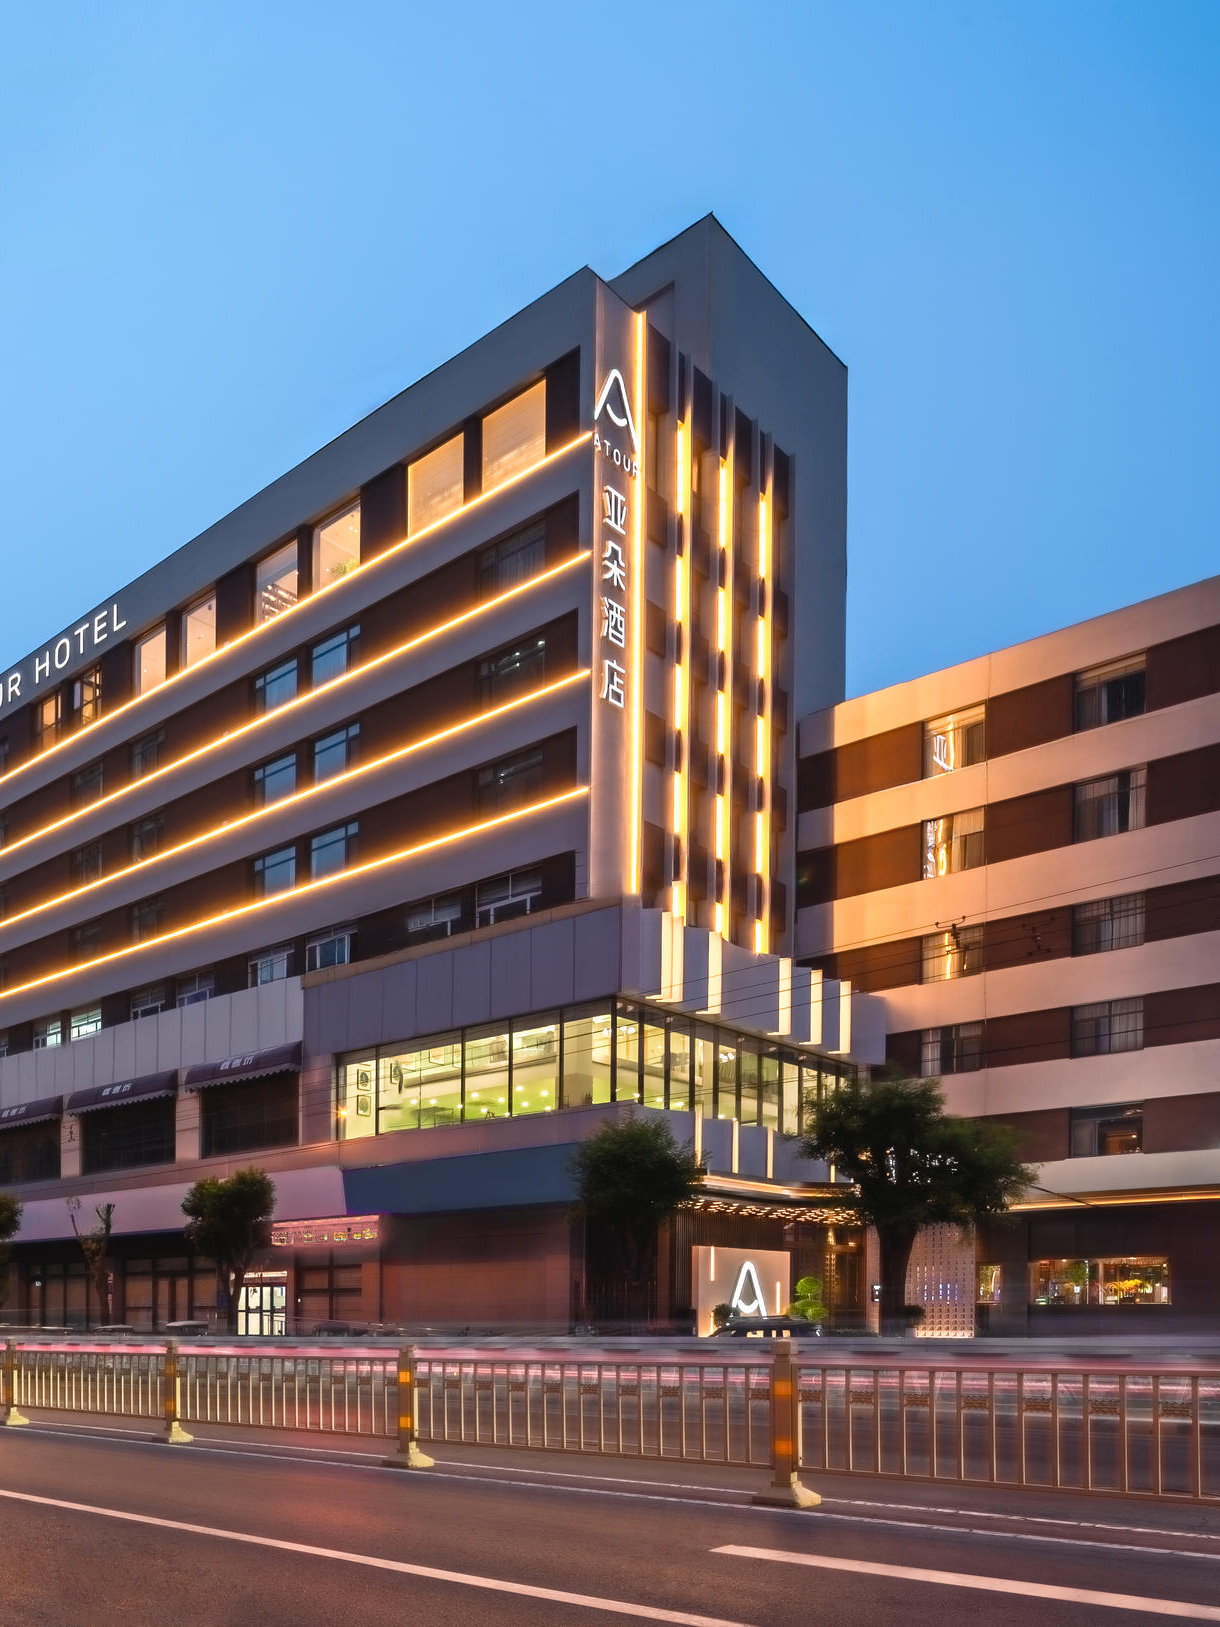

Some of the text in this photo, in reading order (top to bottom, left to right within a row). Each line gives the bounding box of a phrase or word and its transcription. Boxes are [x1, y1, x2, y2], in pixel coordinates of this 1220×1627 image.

[594, 433, 639, 476] ATOUR
[602, 485, 627, 709] 亚朵酒店
[35, 603, 127, 684] HOTEL
